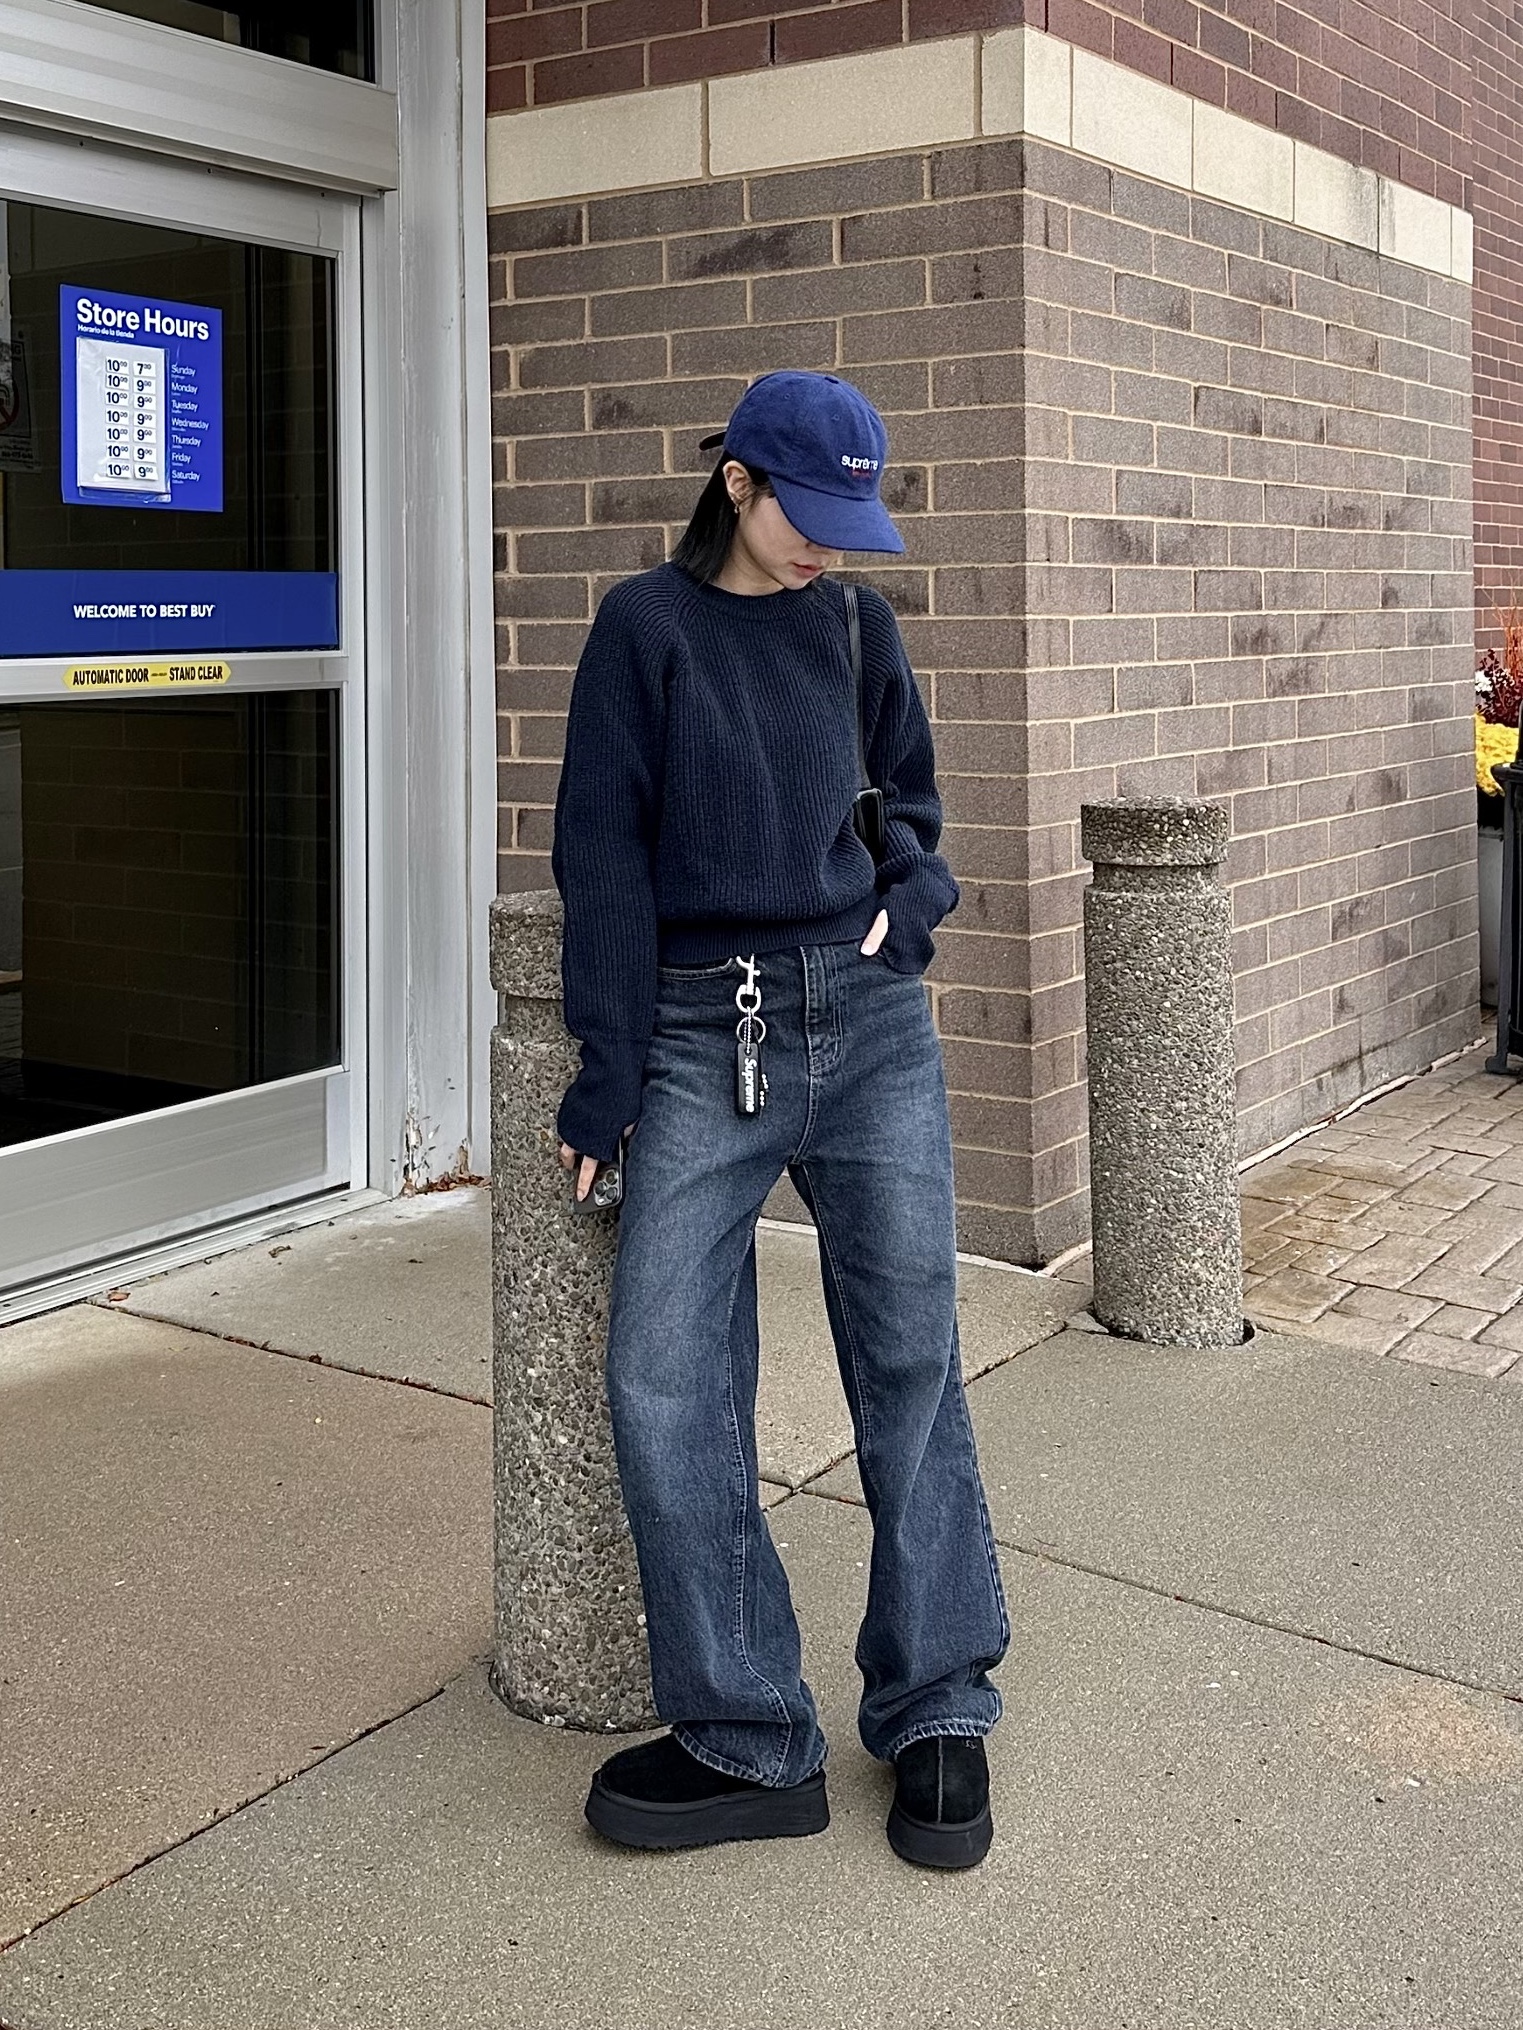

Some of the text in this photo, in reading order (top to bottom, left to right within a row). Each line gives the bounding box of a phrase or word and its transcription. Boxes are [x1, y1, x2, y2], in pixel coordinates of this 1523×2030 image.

[76, 298, 210, 341] Store Hours
[77, 324, 101, 334] Horario
[171, 363, 196, 377] Sunday
[171, 382, 198, 395] Monday
[171, 399, 199, 413] Tuesday
[171, 417, 210, 431] Wednesday
[171, 434, 202, 448] Thursday
[171, 452, 191, 464] Friday
[171, 469, 201, 482] Saturday
[73, 604, 215, 619] WELCOME TO BEST BUY
[72, 665, 223, 686] AUTOMATIC DOOR STAND CLEAR
[741, 1057, 758, 1113] Supreme
